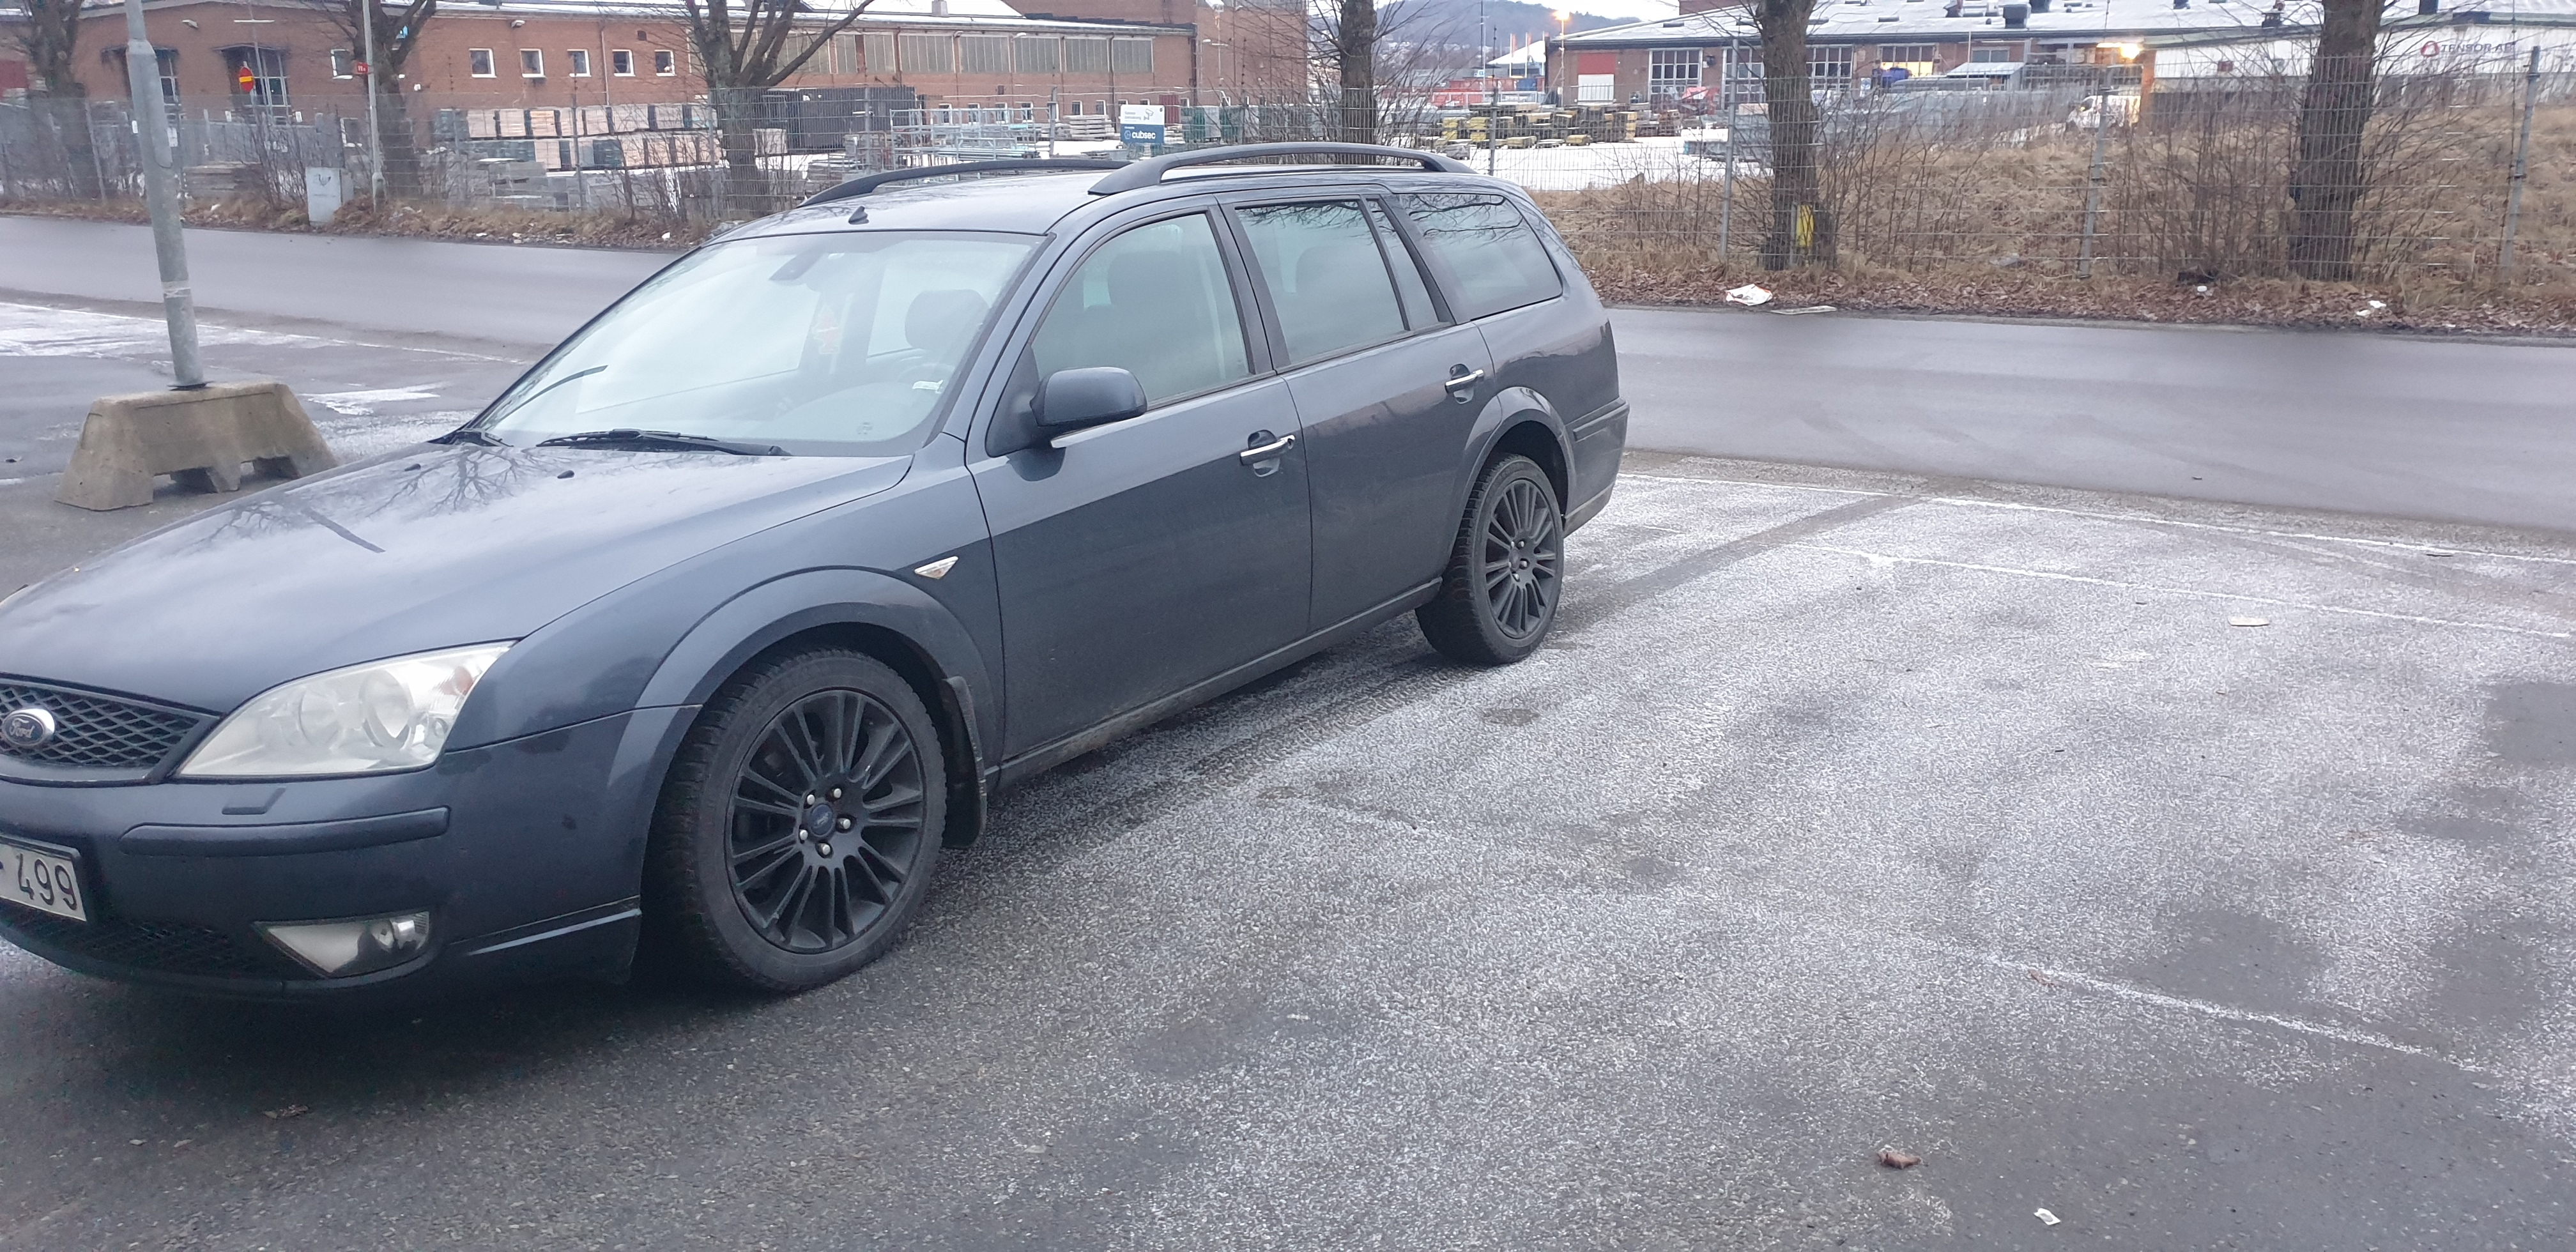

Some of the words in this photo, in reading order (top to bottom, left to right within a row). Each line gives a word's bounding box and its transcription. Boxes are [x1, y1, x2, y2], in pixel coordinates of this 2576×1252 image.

[2441, 43, 2492, 53] TENSOR
[1131, 130, 1156, 139] cubsec
[9, 717, 36, 738] Ford
[16, 853, 78, 911] 499
